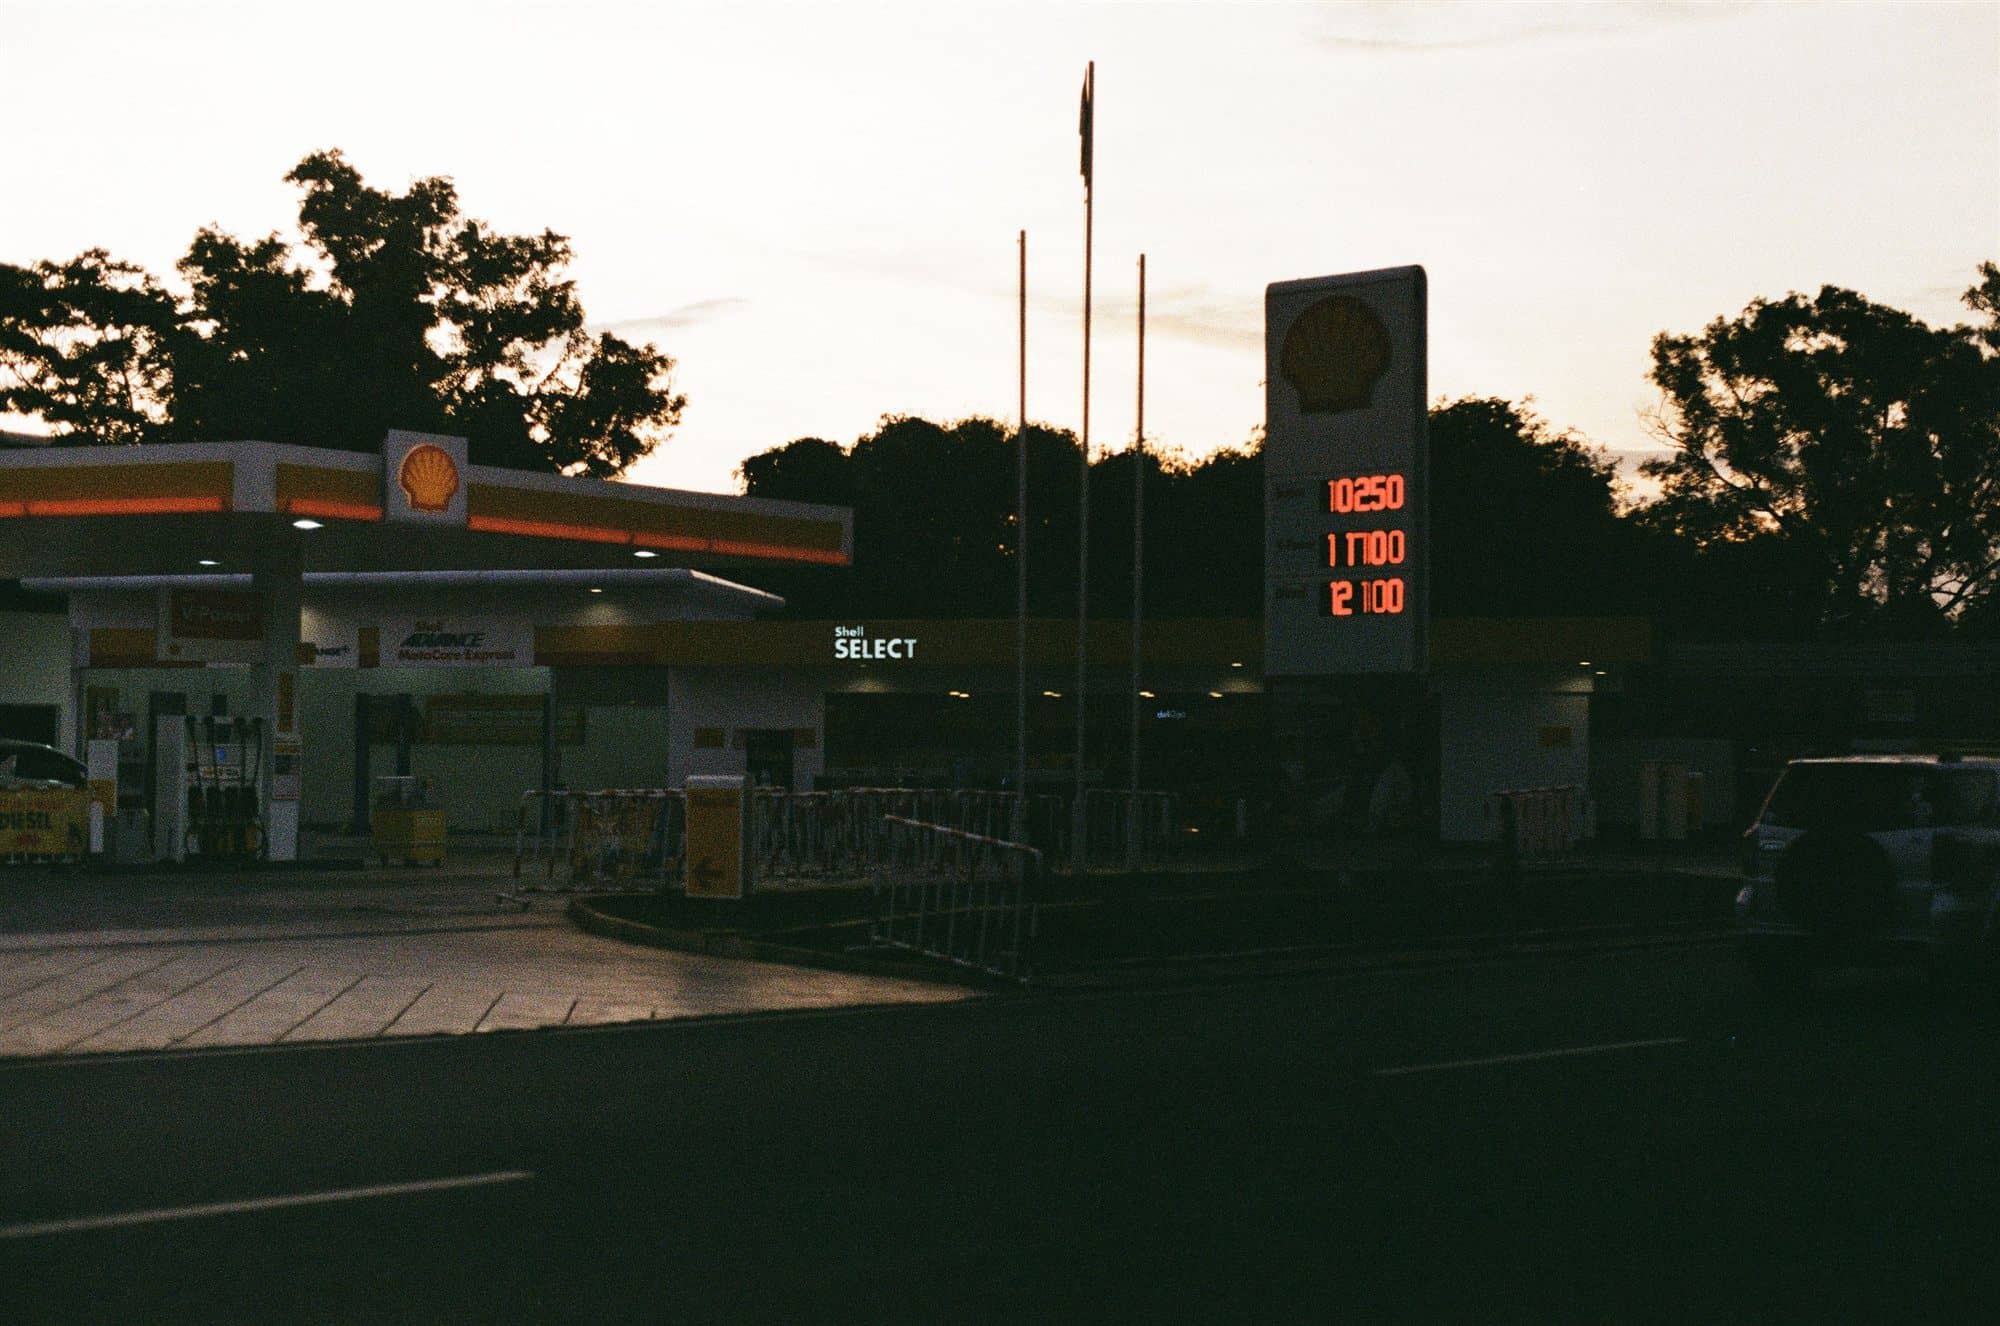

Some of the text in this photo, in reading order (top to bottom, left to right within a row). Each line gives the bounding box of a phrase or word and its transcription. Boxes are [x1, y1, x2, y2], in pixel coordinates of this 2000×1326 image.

[1328, 474, 1405, 513] 10250
[835, 625, 864, 637] Shell
[834, 638, 918, 659] SELECT
[0, 811, 52, 830] DIESEL
